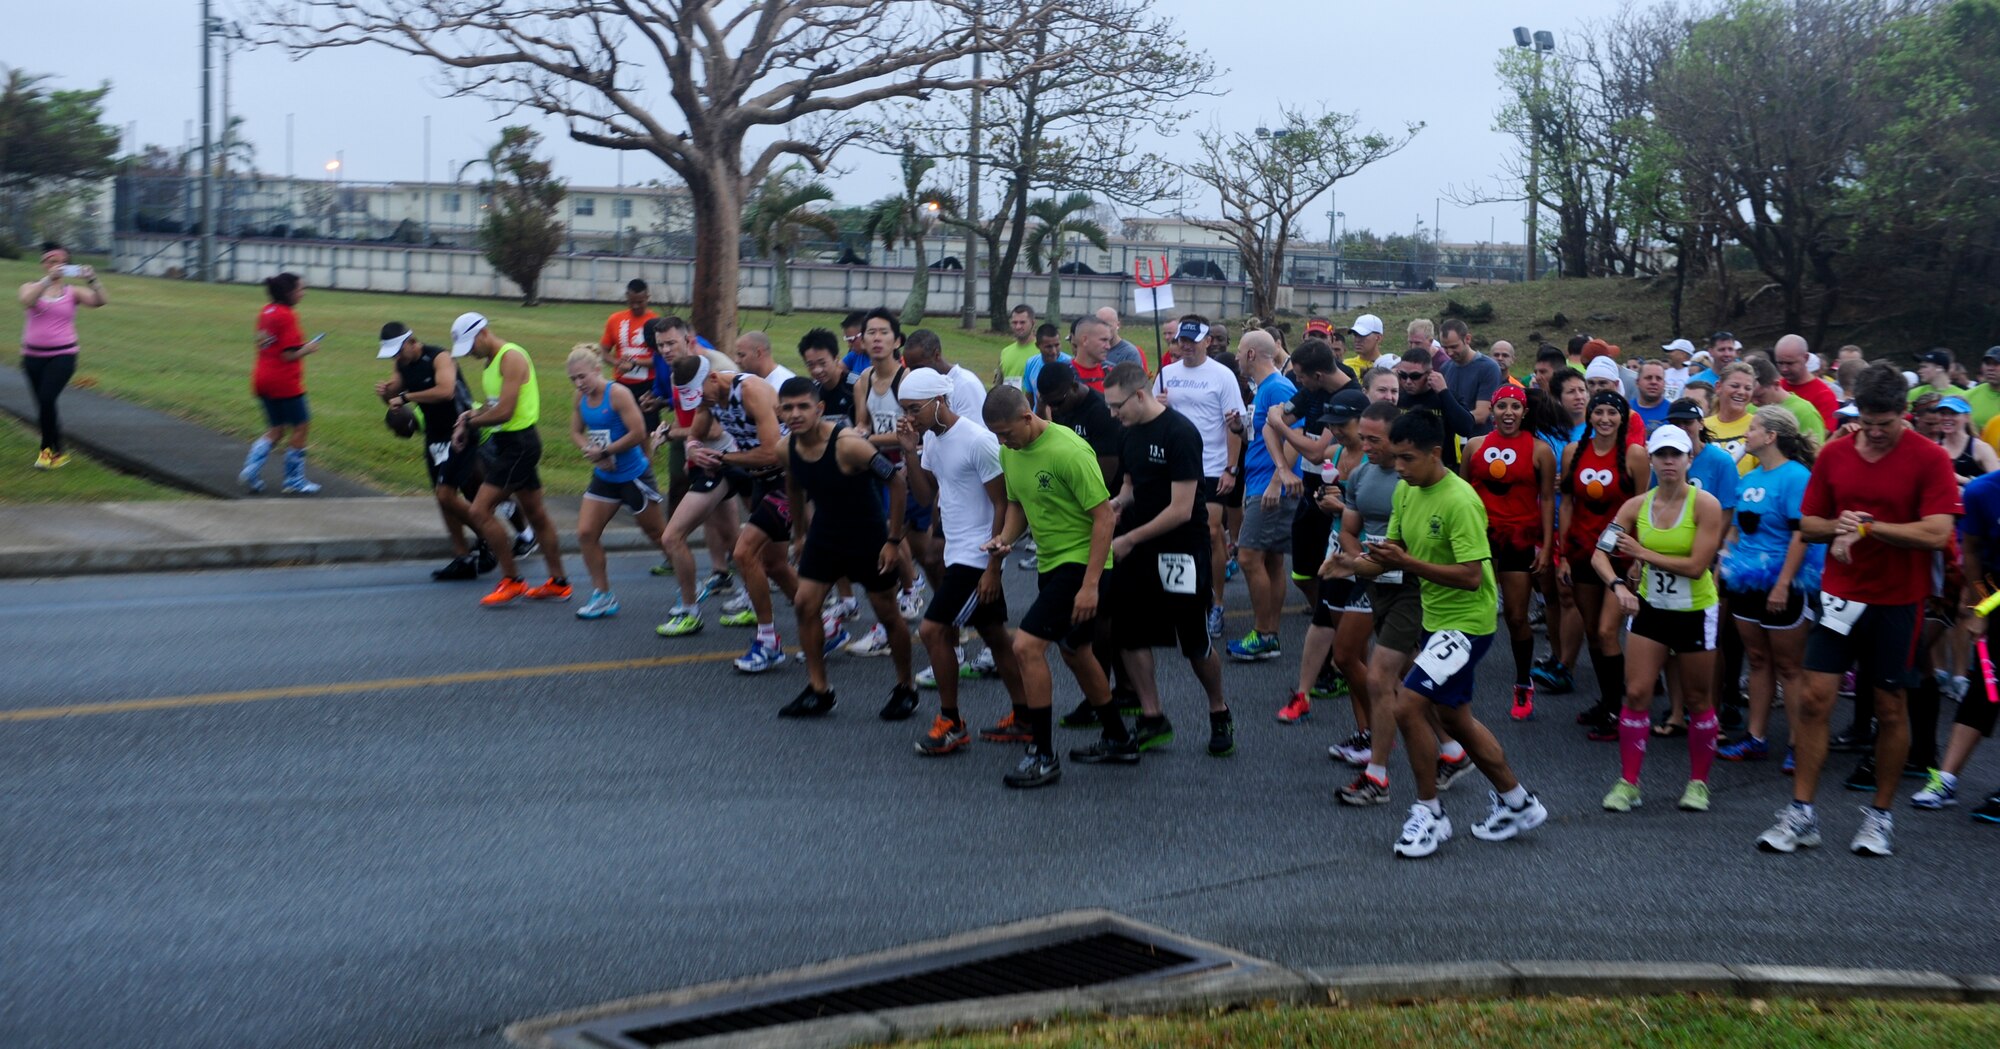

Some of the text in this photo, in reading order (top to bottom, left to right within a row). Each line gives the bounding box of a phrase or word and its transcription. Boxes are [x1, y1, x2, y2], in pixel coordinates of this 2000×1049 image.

[1149, 444, 1165, 459] 13.1
[1166, 563, 1184, 585] 72
[1655, 572, 1678, 594] 32
[1430, 634, 1458, 660] 75
